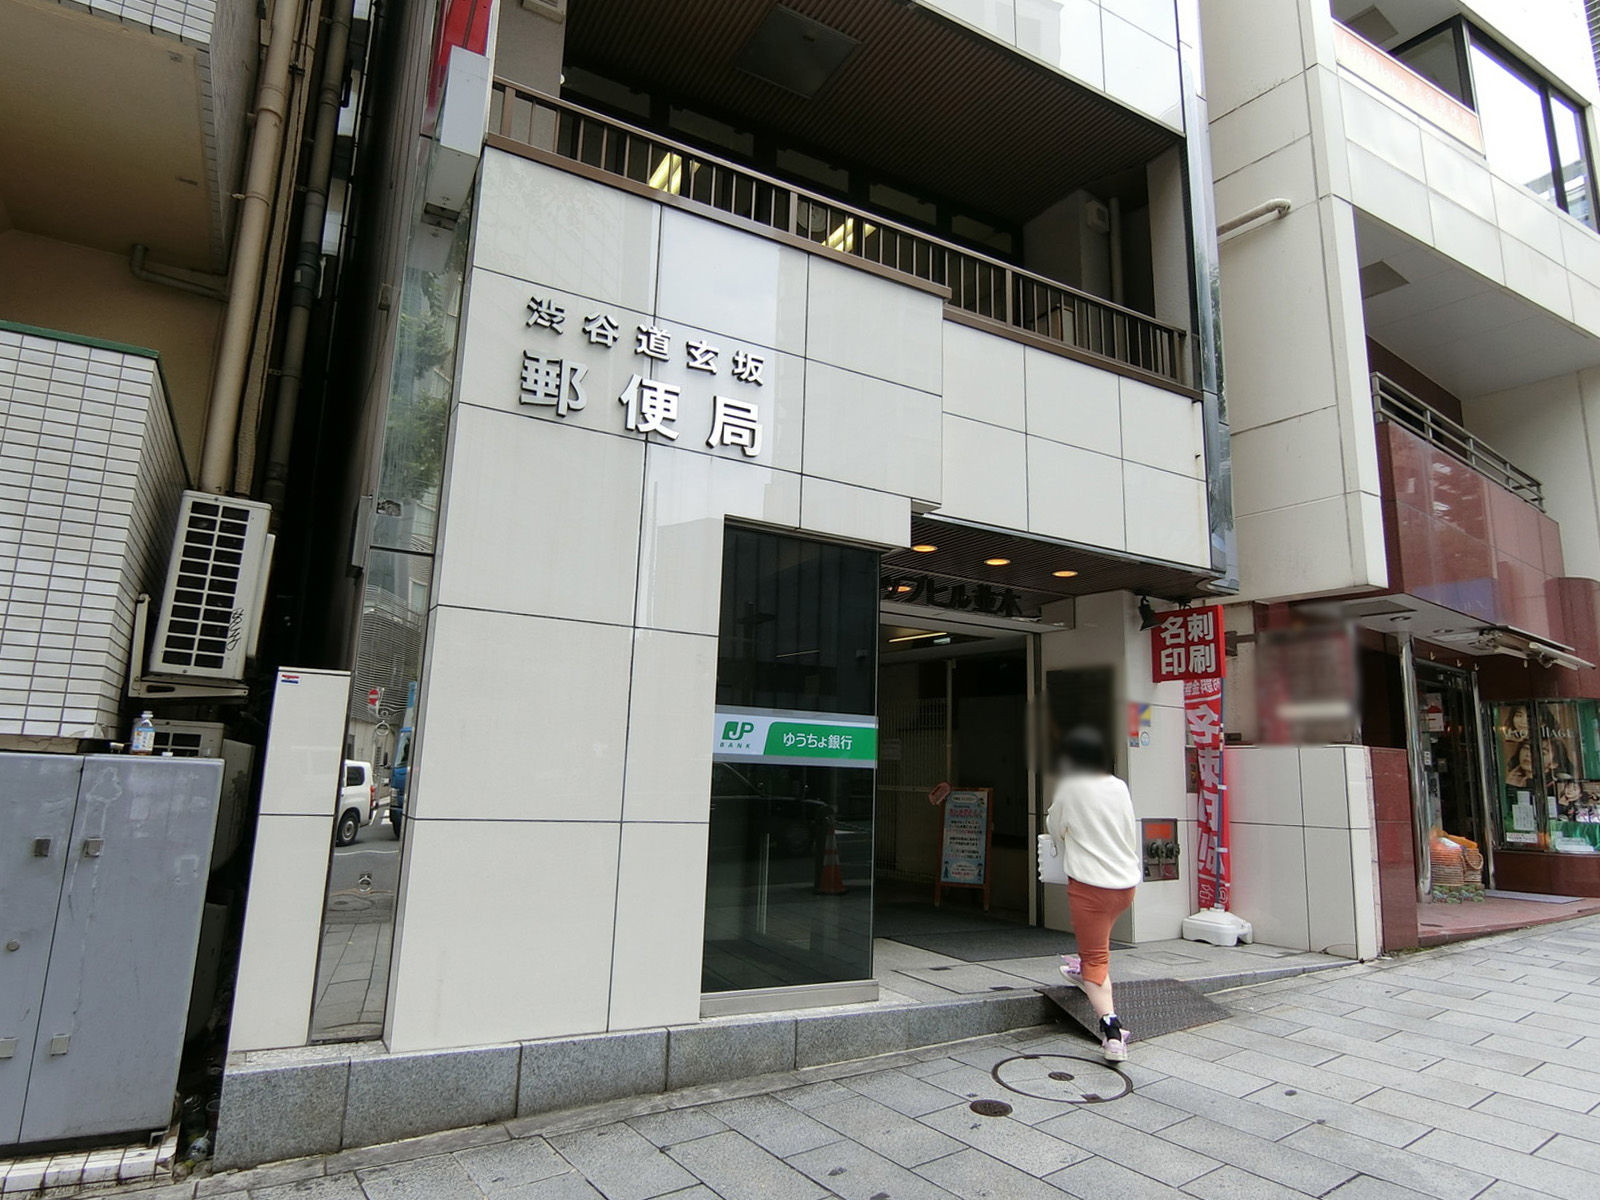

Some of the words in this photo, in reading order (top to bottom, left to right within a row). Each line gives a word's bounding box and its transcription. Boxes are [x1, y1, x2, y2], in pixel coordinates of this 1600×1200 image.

[526, 296, 765, 386] 渋谷道玄坂
[519, 350, 763, 457] 郵便局
[1160, 612, 1214, 646] 名刺
[1160, 643, 1216, 676] 印刷
[722, 721, 754, 741] JP
[783, 732, 853, 751] ゆうちょ銀行
